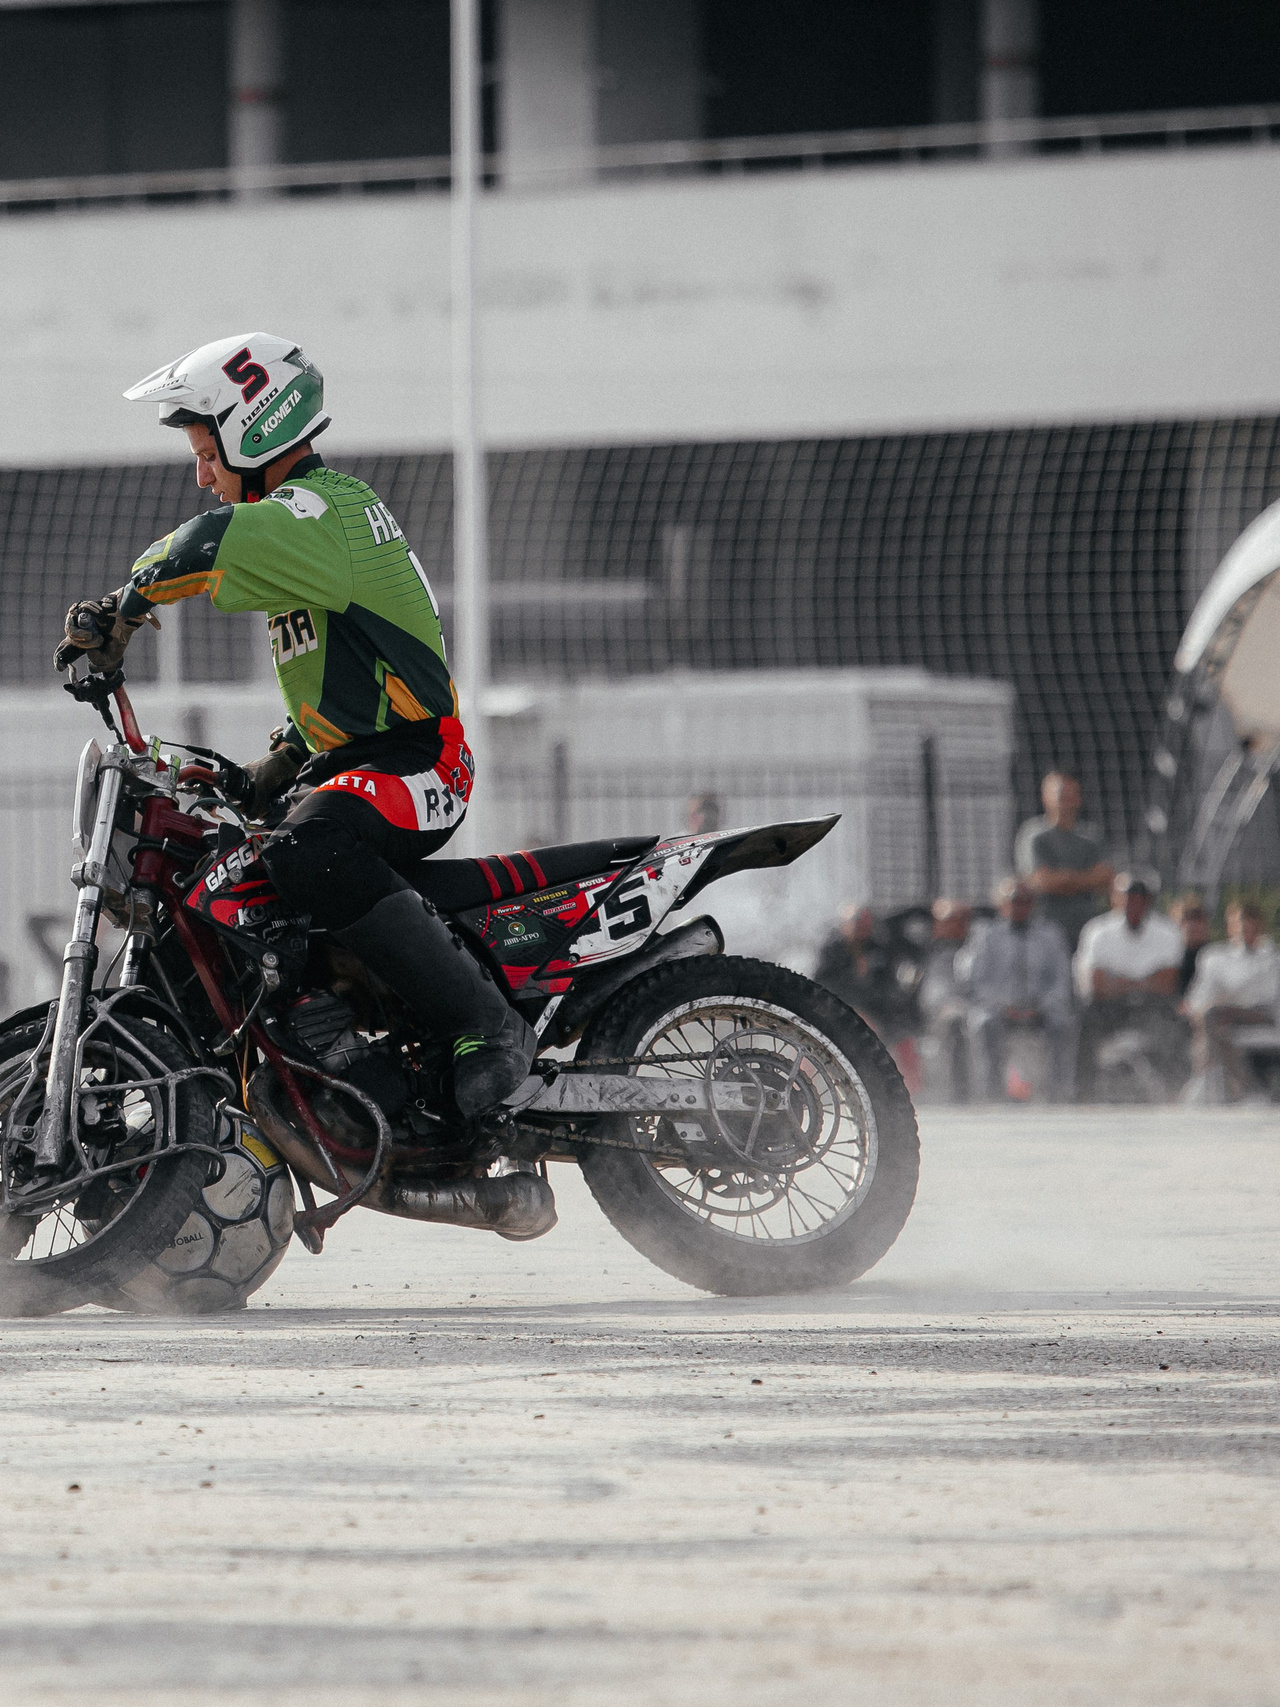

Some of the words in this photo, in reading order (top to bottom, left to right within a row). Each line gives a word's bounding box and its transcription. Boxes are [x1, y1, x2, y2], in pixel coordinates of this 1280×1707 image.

[222, 347, 270, 405] 5
[241, 387, 280, 427] hebo
[578, 877, 606, 889] MOTUL
[585, 871, 653, 945] 5
